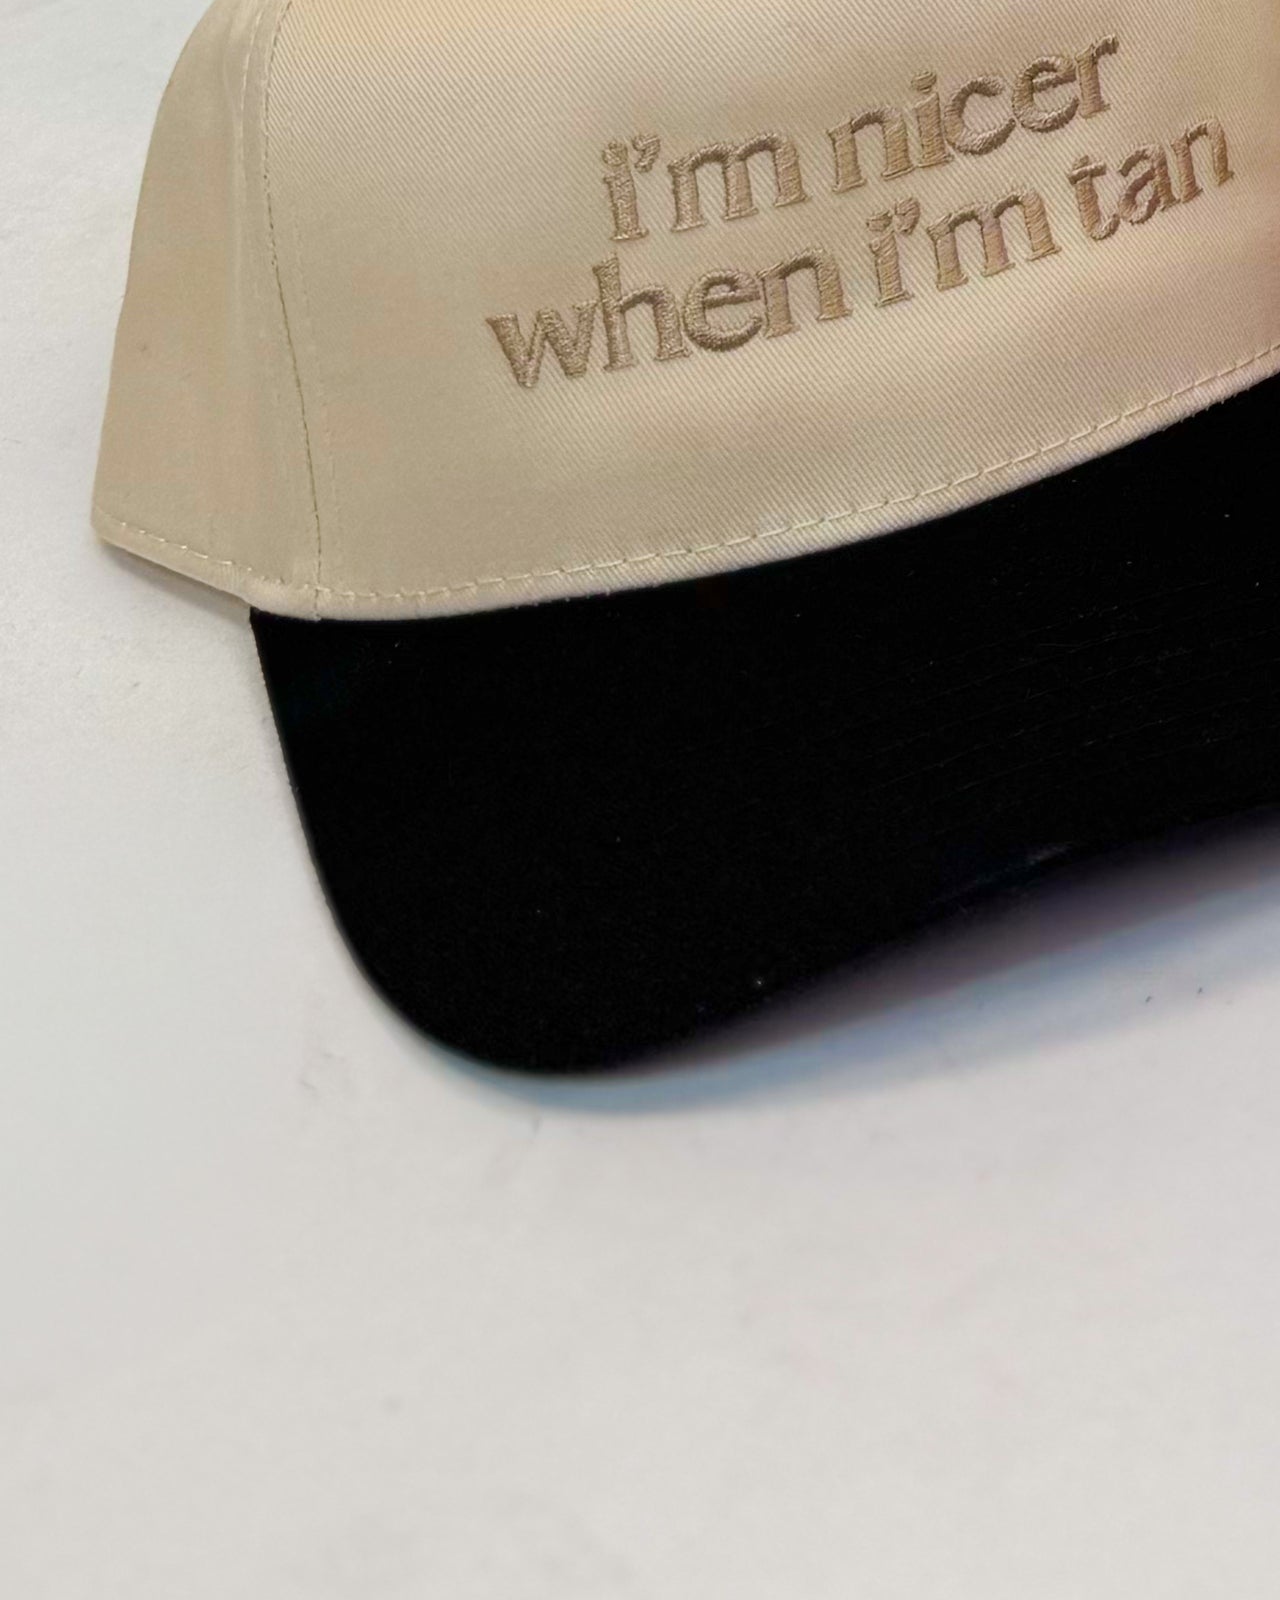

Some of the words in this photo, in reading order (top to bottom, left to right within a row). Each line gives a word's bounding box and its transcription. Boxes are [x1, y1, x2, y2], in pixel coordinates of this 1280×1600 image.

[486, 244, 853, 390] when
[865, 181, 1062, 308] i'm
[1066, 115, 1236, 242] tan
[601, 132, 809, 241] i'm
[826, 32, 1119, 194] nicer
